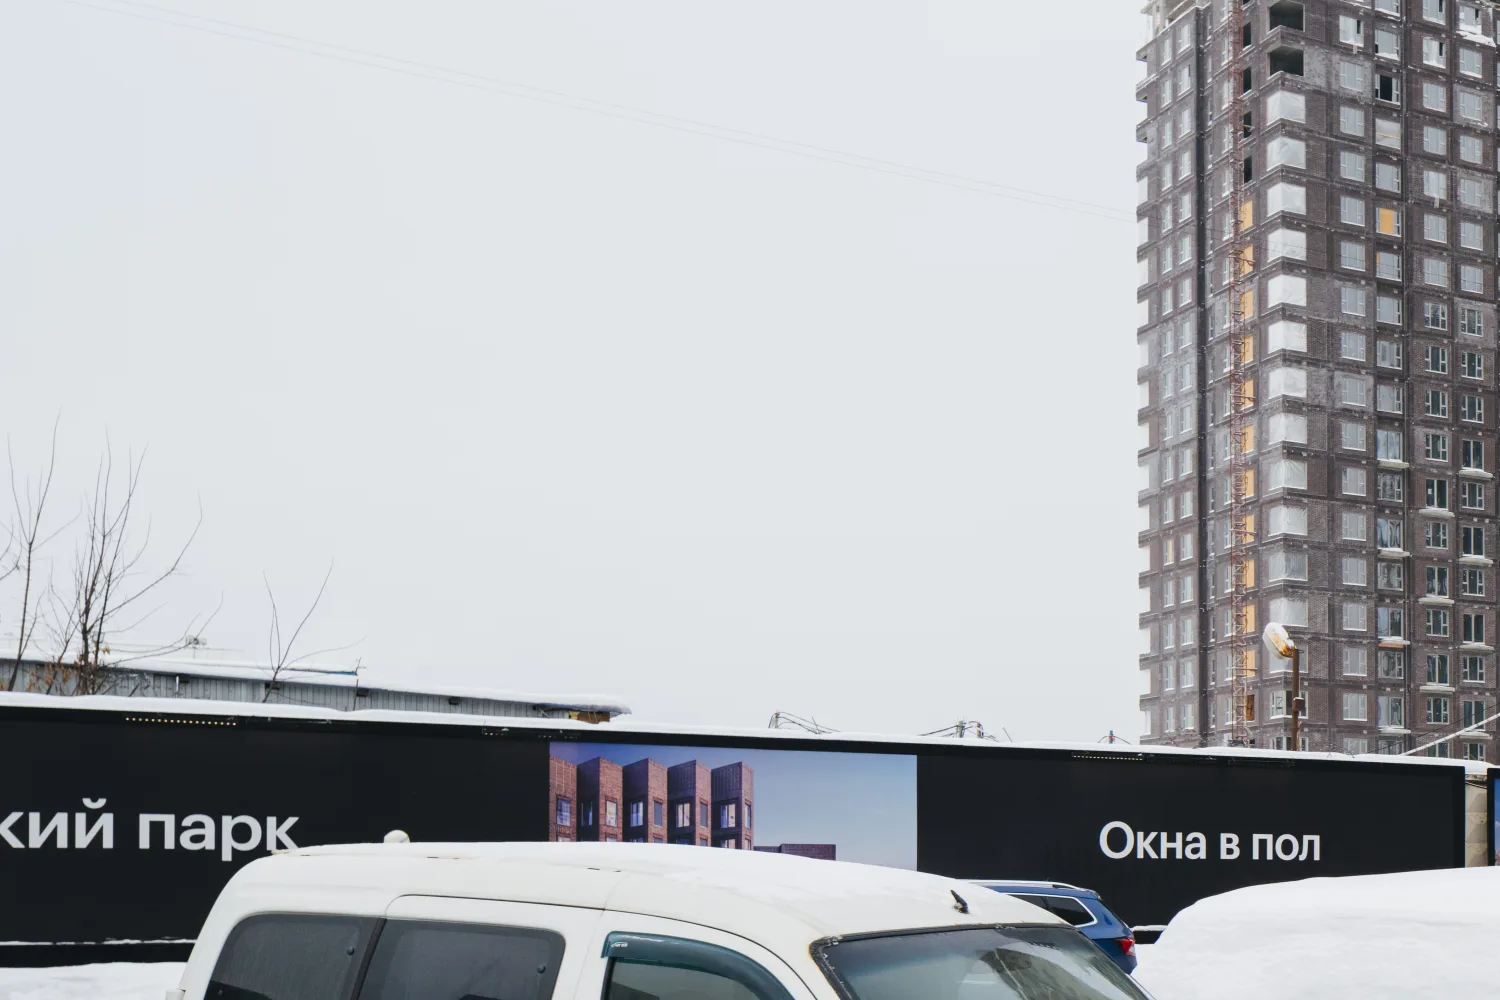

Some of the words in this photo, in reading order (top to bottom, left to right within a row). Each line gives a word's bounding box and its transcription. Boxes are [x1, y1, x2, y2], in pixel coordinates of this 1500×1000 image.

[139, 813, 300, 862] парк
[1100, 821, 1207, 859] Окна
[1220, 833, 1240, 860] в
[1252, 833, 1321, 861] пол
